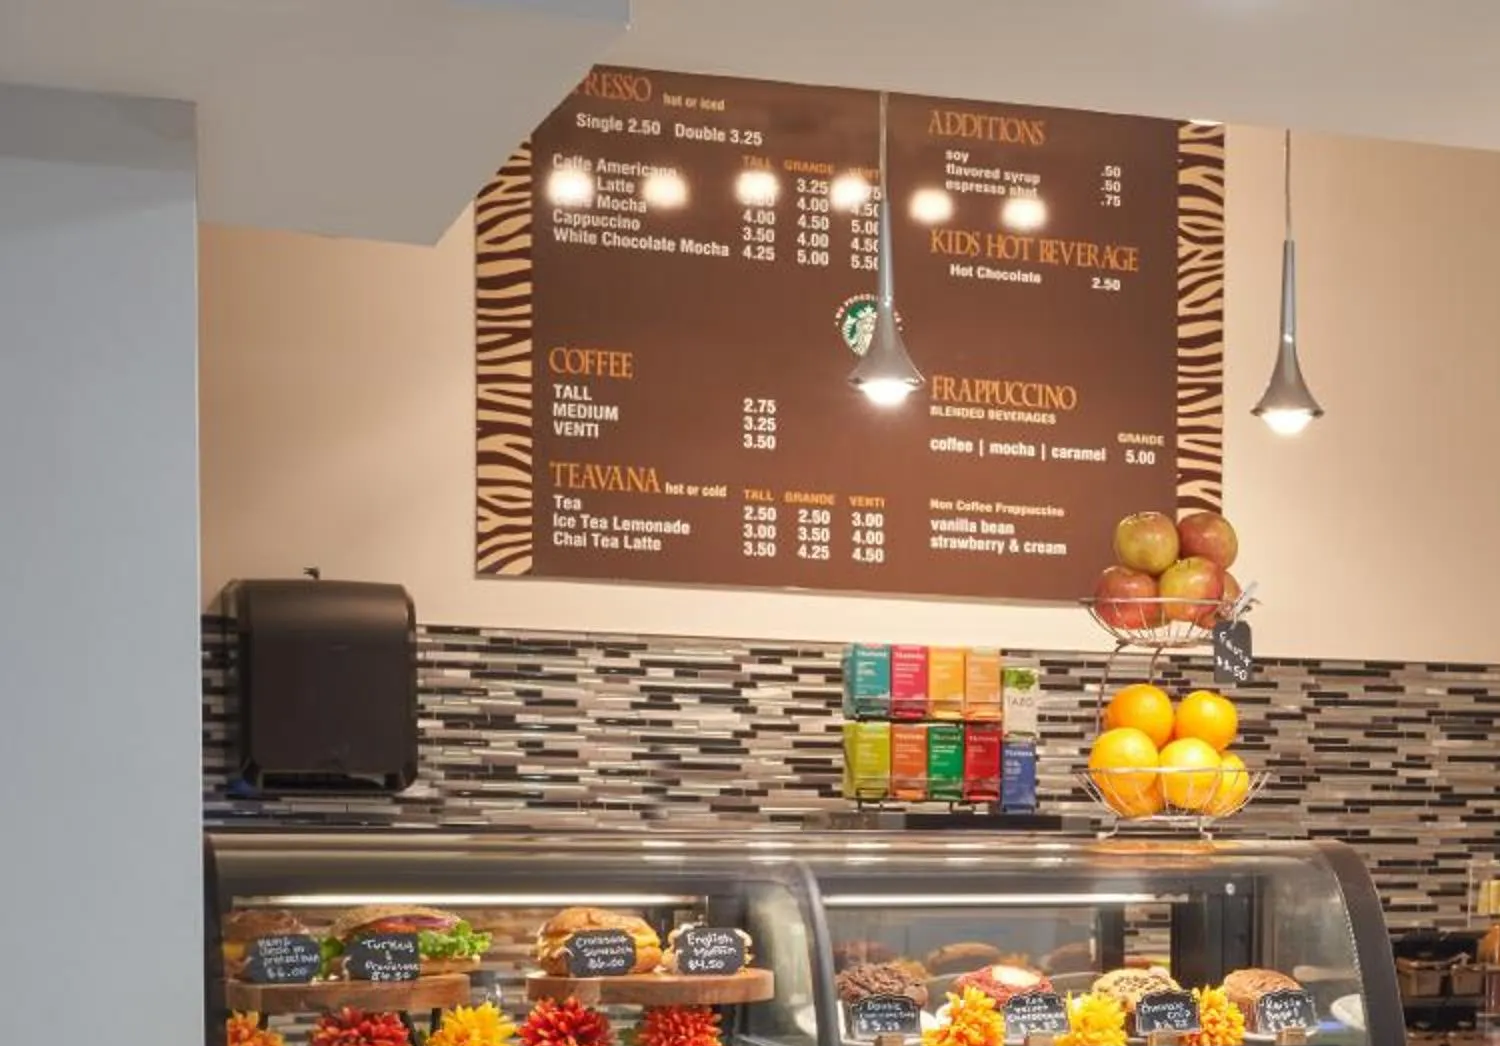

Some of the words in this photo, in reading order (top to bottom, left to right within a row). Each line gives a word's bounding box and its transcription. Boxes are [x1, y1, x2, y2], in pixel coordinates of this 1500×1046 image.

[577, 71, 651, 101] RESSO
[663, 93, 683, 109] hot
[685, 97, 698, 109] or
[700, 96, 725, 111] iced
[576, 112, 624, 133] Single
[627, 117, 661, 135] 2.50
[675, 123, 726, 142] Double
[729, 128, 763, 146] 3.25
[928, 110, 1045, 146] ADDITIONS
[784, 158, 835, 174] GRANDE
[945, 150, 969, 163] soy
[1100, 165, 1121, 179] .50
[945, 163, 1001, 180] flavored
[1003, 170, 1041, 186] syrup
[1100, 180, 1121, 193] .50
[597, 178, 635, 194] Latte
[797, 197, 829, 213] 4.00
[796, 178, 829, 195] 3.25
[945, 179, 1006, 196] espresso
[1009, 182, 1038, 198] shot
[1100, 194, 1121, 208] .75
[553, 208, 641, 231] Cappuccino
[743, 227, 775, 243] 3.50
[797, 231, 829, 248] 4.00
[597, 196, 647, 213] Mocha
[743, 210, 775, 225] 4.00
[797, 214, 829, 231] 4.50
[553, 227, 598, 246] White
[602, 231, 675, 253] Chocolate
[680, 240, 729, 257] Mocha
[743, 245, 775, 262] 4.25
[797, 250, 829, 266] 5.00
[929, 228, 980, 257] KIDS
[987, 234, 1036, 263] HOT
[1039, 239, 1140, 274] BEVERAGE
[949, 262, 974, 279] Hot
[977, 265, 1042, 285] Chocolate
[1092, 276, 1121, 291] 2.50
[548, 346, 633, 380] COFFEE
[553, 383, 592, 402] TALL
[743, 398, 776, 415] 2.75
[931, 375, 1078, 412] FRAPPUCCINO
[553, 402, 619, 421] MEDIUM
[743, 416, 777, 432] 3.25
[929, 405, 985, 420] BLENDED
[987, 409, 1056, 425] BEVERAGES
[553, 421, 599, 438] VENTI
[743, 433, 776, 450] 3.50
[929, 436, 973, 454] coffee
[989, 439, 1035, 458] mocha
[1051, 444, 1106, 462] caramel
[1117, 432, 1165, 447] GRANDE
[1124, 449, 1155, 466] 5.00
[549, 460, 661, 493] TEAVANA
[665, 481, 684, 496] hot
[687, 484, 699, 497] or
[701, 484, 728, 498] cold
[743, 488, 774, 501] TALL
[784, 490, 835, 506] GRANDE
[848, 494, 885, 509] VENTI
[553, 494, 581, 511] Tea
[743, 505, 777, 522] 2.50
[851, 511, 884, 528] 3.00
[929, 498, 953, 511] Non
[955, 499, 992, 514] Coffee
[995, 502, 1065, 518] Frappuccino
[553, 513, 577, 529] Ice
[580, 515, 608, 531] Tea
[612, 516, 691, 536] Lemonade
[743, 524, 777, 540] 3.00
[797, 526, 830, 543] 3.50
[851, 529, 884, 546] 4.00
[930, 516, 977, 533] vanilla
[981, 519, 1014, 535] bean
[553, 531, 586, 548] Chai
[590, 533, 619, 549] Tea
[623, 535, 662, 552] Latte
[743, 541, 777, 557] 3.50
[797, 544, 830, 561] 4.25
[852, 547, 884, 564] 4.50
[930, 533, 1005, 554] strawberry
[1008, 538, 1020, 552] &
[1023, 540, 1067, 555] cream
